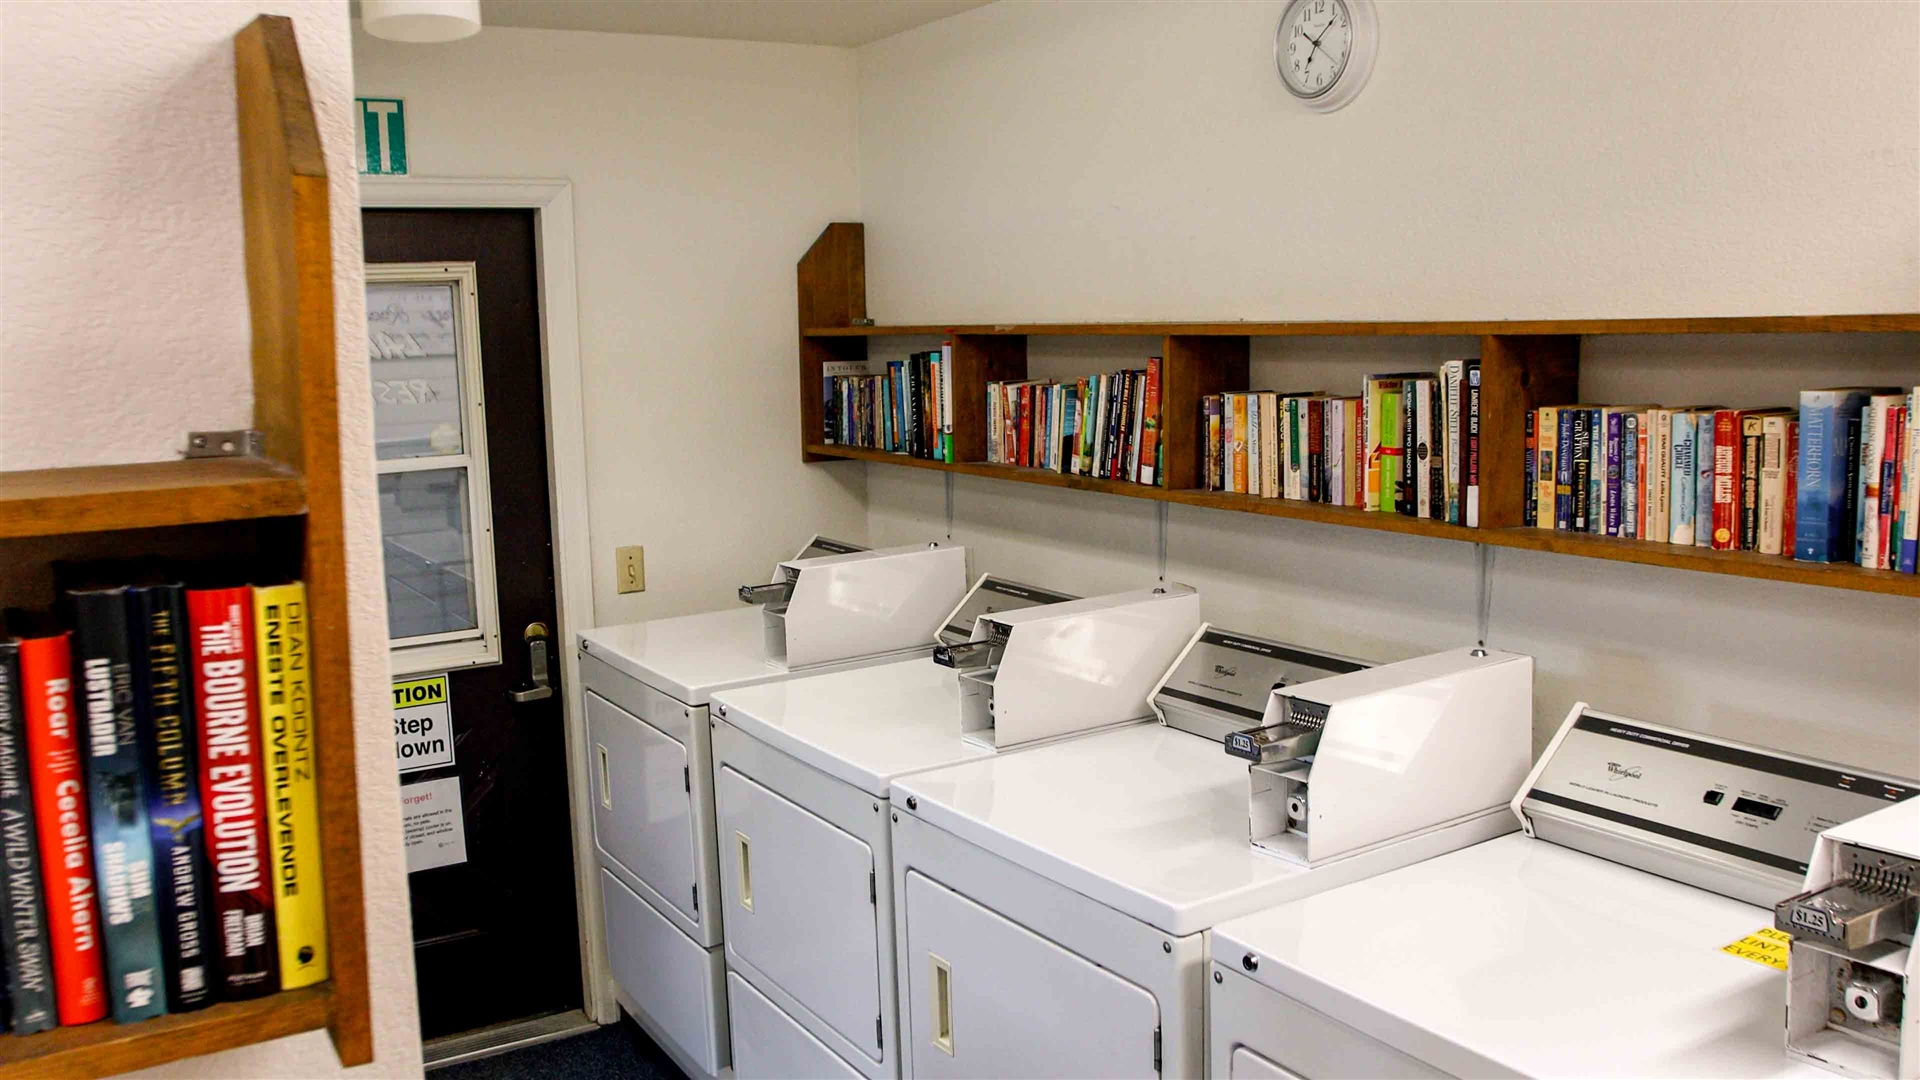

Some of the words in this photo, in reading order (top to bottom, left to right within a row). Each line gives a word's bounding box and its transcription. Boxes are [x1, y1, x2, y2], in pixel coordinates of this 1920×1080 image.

[1294, 24, 1304, 38] 10
[355, 101, 398, 174] IT
[1450, 365, 1460, 407] DANIELLE
[1470, 389, 1478, 416] LAWRENCE
[1450, 409, 1460, 434] STEEL
[1470, 417, 1478, 434] BLOCK
[1574, 420, 1582, 460] GRAFTON
[1582, 432, 1590, 448] SUE
[1867, 400, 1878, 442] CATHERINE
[1470, 436, 1478, 451] EIGHT
[1470, 452, 1478, 473] MILLION
[1674, 444, 1683, 470] CIRCLE
[1683, 439, 1692, 476] CHARMED
[1806, 406, 1824, 488] MATTERHORN
[1865, 443, 1876, 480] COOKSON
[1470, 474, 1478, 486] WAY
[1626, 482, 1636, 510] AMERICAN
[150, 610, 172, 636] THE
[198, 620, 234, 656] THE
[286, 602, 307, 671] DEAN
[264, 604, 287, 706] ENESTE
[112, 663, 132, 704] ERIC
[150, 644, 182, 706] FIFTH
[393, 683, 442, 704] TION
[44, 678, 72, 738] Roar
[84, 658, 117, 757] LUSTBADER
[202, 658, 251, 760] BOURNE
[116, 708, 136, 746] VAN
[290, 680, 311, 781] KOONTZ
[1234, 736, 1249, 748] $1.25
[156, 716, 187, 806] COLUMN
[397, 738, 445, 759] own
[1608, 765, 1642, 780] Whirlpool
[270, 716, 300, 897] OVERLEVENDE
[403, 792, 433, 805] orget!
[56, 779, 88, 869] Cecelia
[208, 762, 262, 894] EVOLUTION
[102, 841, 134, 925] SHADOWS
[170, 845, 192, 907] ANDREW
[9, 871, 38, 939] WINTER
[67, 877, 96, 952] Ahern
[1795, 908, 1824, 928] $1.25
[178, 912, 201, 959] GROSS
[222, 909, 246, 958] FREEMAN
[243, 912, 266, 948] BRIAN
[1740, 937, 1786, 952] LINT
[1758, 928, 1790, 941] PLE
[17, 943, 44, 992] SWAN
[1722, 944, 1785, 964] EVERY
